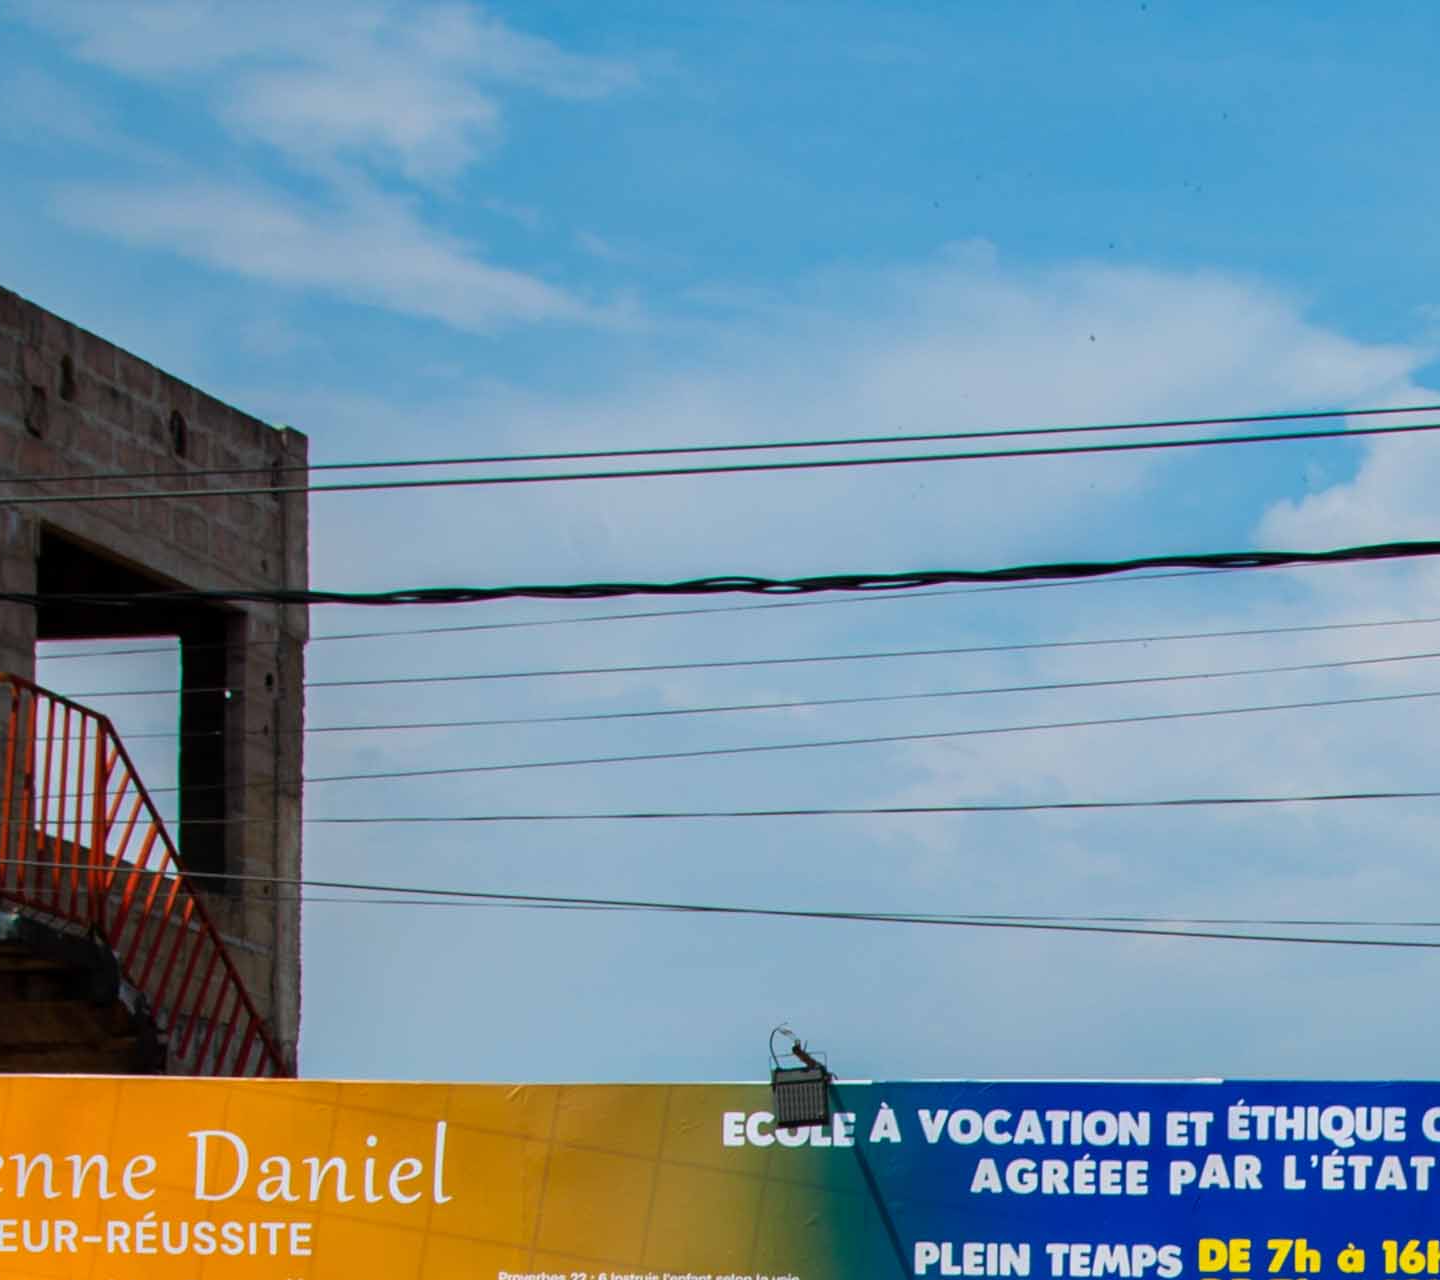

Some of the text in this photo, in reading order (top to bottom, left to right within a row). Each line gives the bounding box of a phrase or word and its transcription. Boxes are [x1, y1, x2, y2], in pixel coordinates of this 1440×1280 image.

[723, 1112, 856, 1147] ECOLE
[871, 1102, 902, 1144] À
[918, 1109, 1150, 1146] VOCATION
[1166, 1110, 1214, 1146] ET
[1228, 1099, 1406, 1148] ÉTHIQUE
[188, 1121, 452, 1204] Daniel
[970, 1149, 1436, 1196] AGRÉEE PAR L'ÉTAT
[914, 1241, 1030, 1277] PLEIN
[1046, 1243, 1183, 1278] TEMPS
[1198, 1238, 1251, 1273] DE
[1267, 1238, 1322, 1274] 7h
[1337, 1243, 1365, 1274] à
